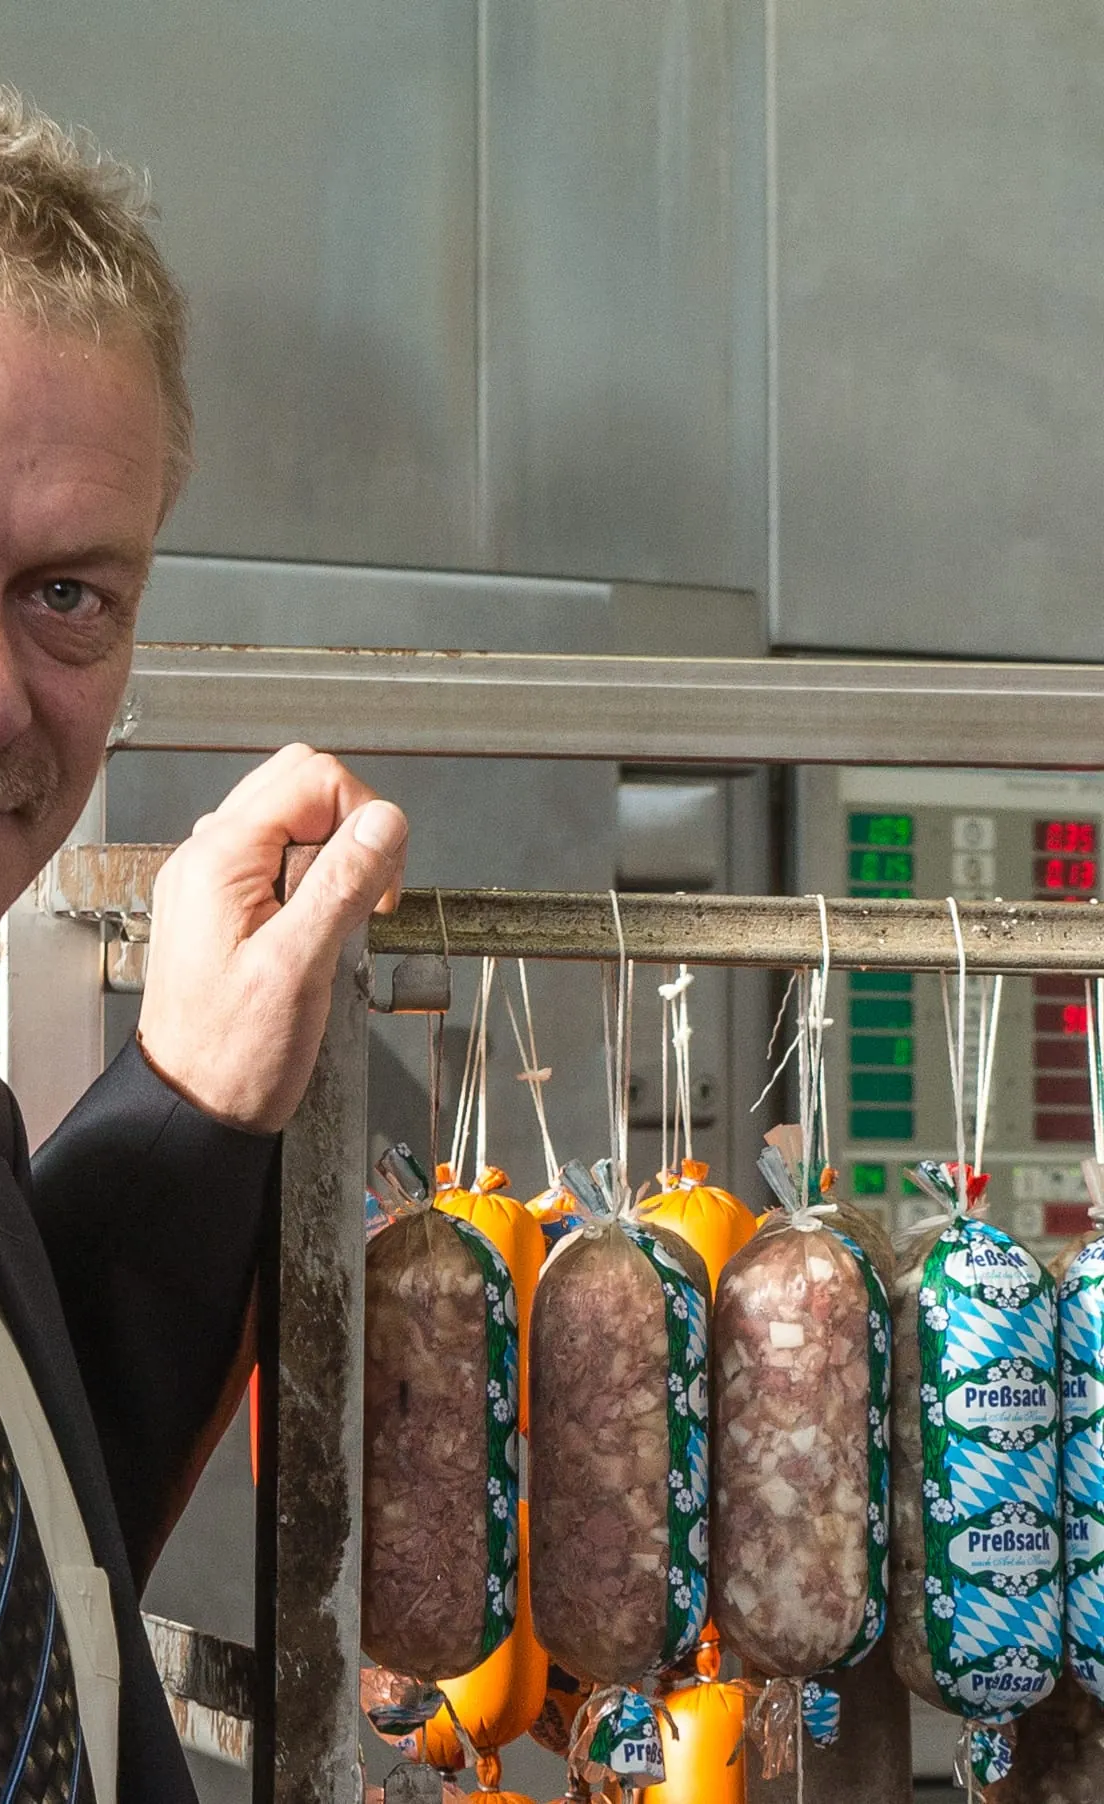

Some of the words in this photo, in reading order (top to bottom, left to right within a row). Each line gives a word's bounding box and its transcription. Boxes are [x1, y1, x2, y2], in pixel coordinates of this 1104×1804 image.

[965, 1384, 1047, 1409] Preßsack
[968, 1528, 1050, 1553] Preßsack
[623, 1741, 664, 1765] Preßs
